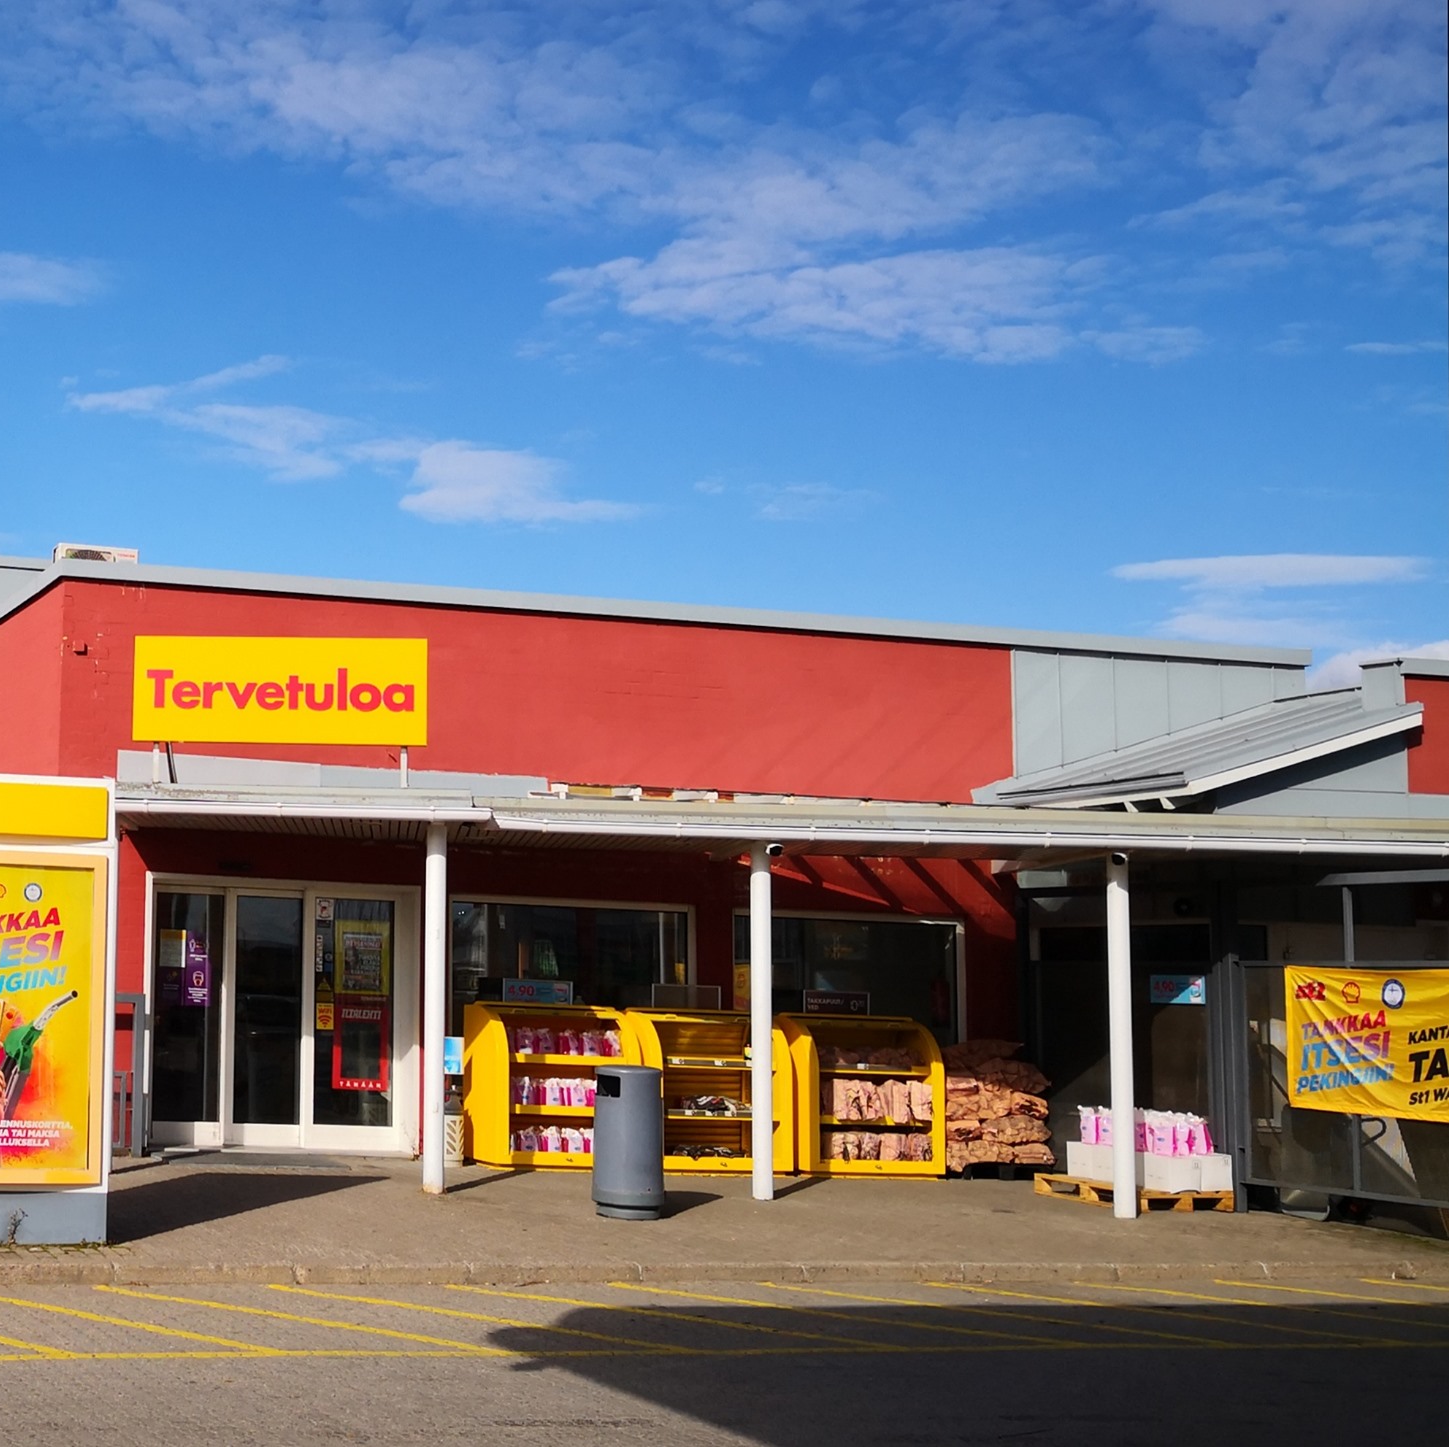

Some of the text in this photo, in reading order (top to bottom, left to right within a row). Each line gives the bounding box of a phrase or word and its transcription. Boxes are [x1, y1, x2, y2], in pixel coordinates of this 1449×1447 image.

[146, 667, 415, 713] Tervetuloa
[1302, 1010, 1387, 1041] TANKKAA
[1302, 1031, 1391, 1072] ITSESI
[1297, 1063, 1395, 1094] PEKINGIIN!
[1409, 1089, 1430, 1105] St1
[12, 1129, 26, 1137] TAI
[27, 1129, 60, 1138] MAKSA
